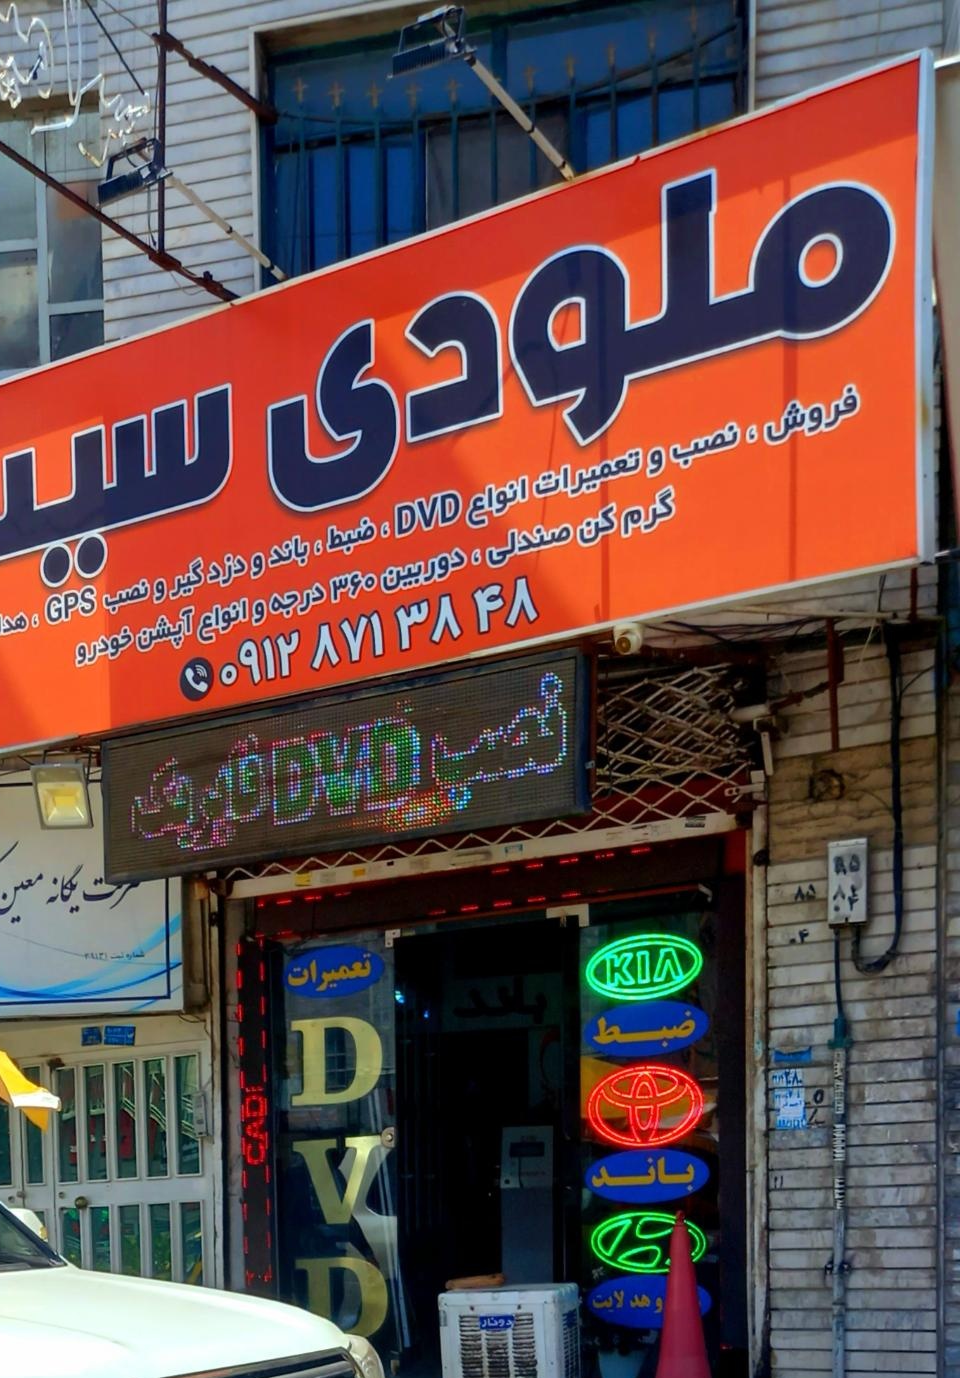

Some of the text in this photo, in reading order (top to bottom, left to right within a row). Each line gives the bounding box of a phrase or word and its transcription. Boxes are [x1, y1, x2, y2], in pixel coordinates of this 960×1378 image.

[267, 168, 896, 513] ملودی
[764, 384, 860, 442] فروش
[647, 447, 664, 475] و
[671, 423, 739, 467] نصب
[533, 449, 642, 497] تعمیرات
[395, 491, 462, 538] DVD
[468, 477, 528, 528] انواع
[622, 486, 675, 538] گرم
[327, 517, 376, 552] ضبط
[487, 523, 573, 567] صندلی
[577, 504, 616, 547] کن
[250, 552, 265, 577] و
[269, 536, 309, 566] باند
[381, 549, 467, 593] دوربین
[45, 586, 97, 625] GPS
[103, 580, 150, 610] نصب
[154, 578, 166, 602] و
[270, 584, 325, 616] درجه
[329, 572, 376, 601] ۳۶۰
[136, 608, 194, 654] آپشن
[197, 600, 248, 642] انواع
[218, 575, 539, 686] ۰۹۱۲ ۸۷۱ ۳۸ ۴۸
[252, 599, 266, 625] و
[75, 626, 133, 667] خودرو
[271, 715, 423, 827] DVD
[45, 864, 84, 914] یگانه
[287, 951, 372, 992] تعمیرات
[604, 947, 685, 987] KIA
[591, 1009, 696, 1048] ضبط
[590, 1156, 696, 1190] باند
